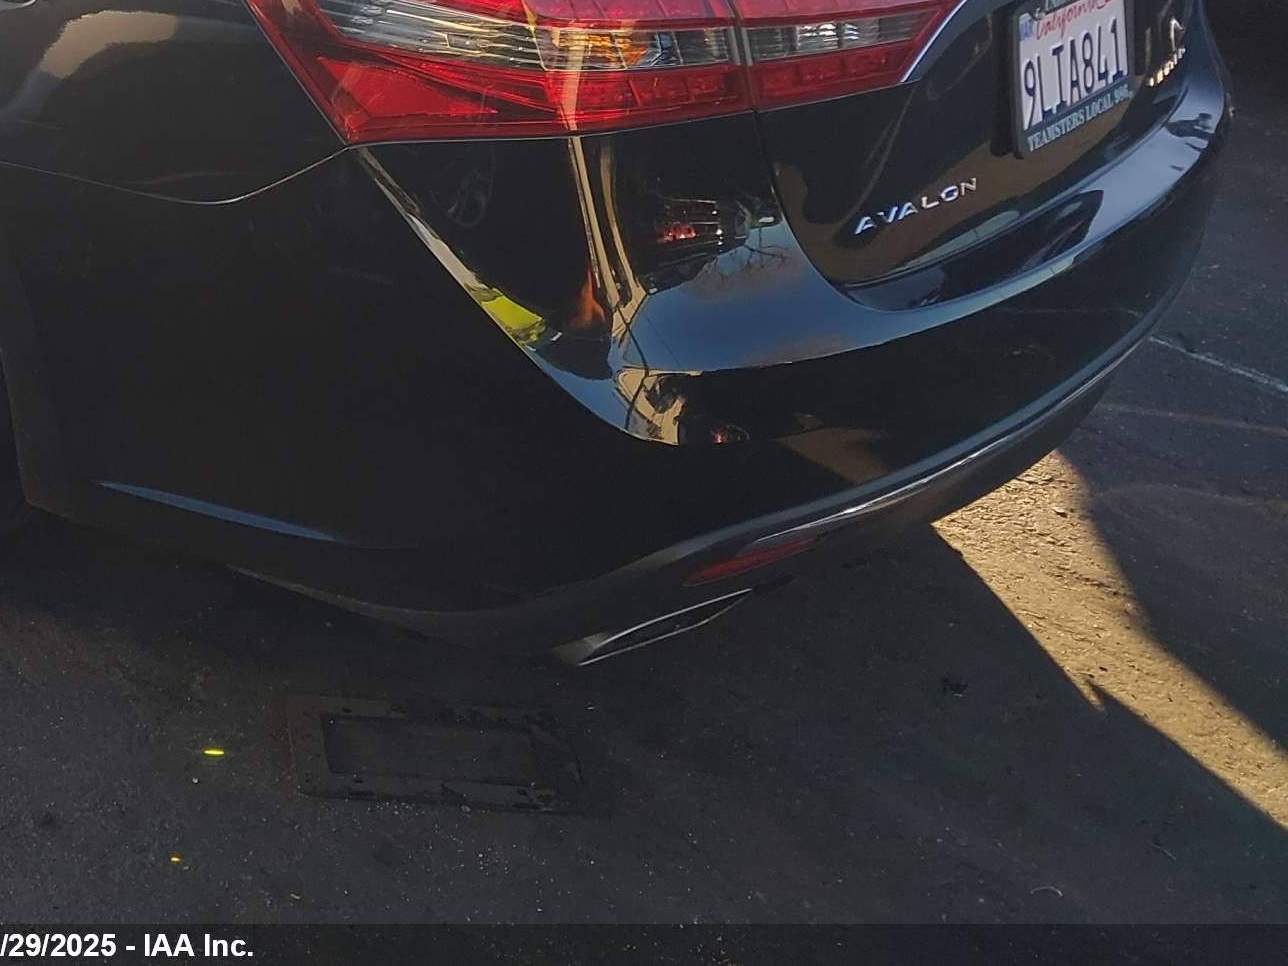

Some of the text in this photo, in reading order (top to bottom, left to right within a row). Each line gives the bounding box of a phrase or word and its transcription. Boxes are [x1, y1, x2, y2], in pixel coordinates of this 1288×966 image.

[1024, 18, 1125, 131] 9LIA841
[1027, 108, 1085, 152] TEAMSTERS
[1085, 93, 1114, 121] LOCAL
[855, 177, 977, 235] AVALON
